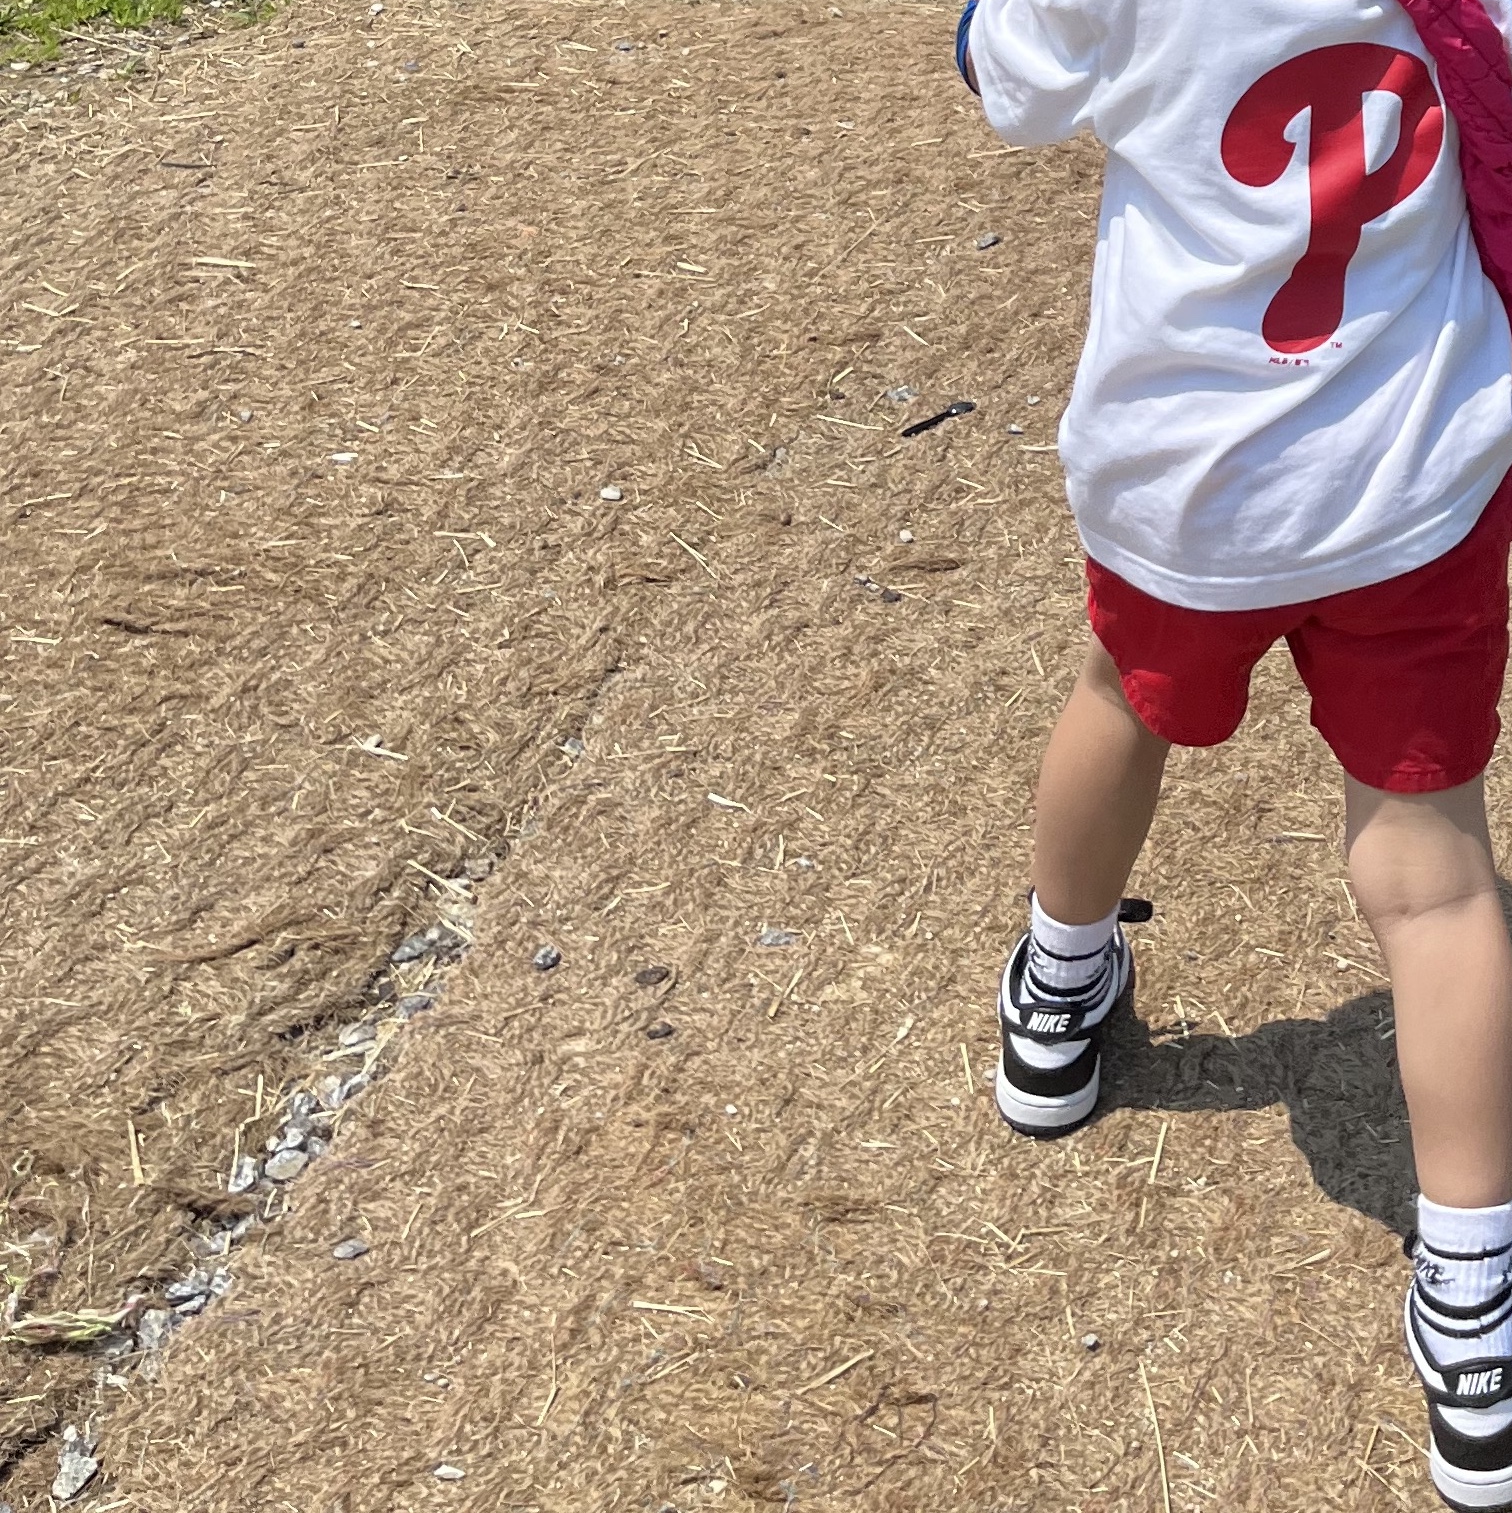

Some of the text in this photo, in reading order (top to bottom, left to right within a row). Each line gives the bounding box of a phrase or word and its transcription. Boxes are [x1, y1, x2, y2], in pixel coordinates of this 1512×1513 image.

[1220, 41, 1445, 355] P
[1026, 1011, 1071, 1033] NIKE
[1456, 1367, 1503, 1396] NIKE
